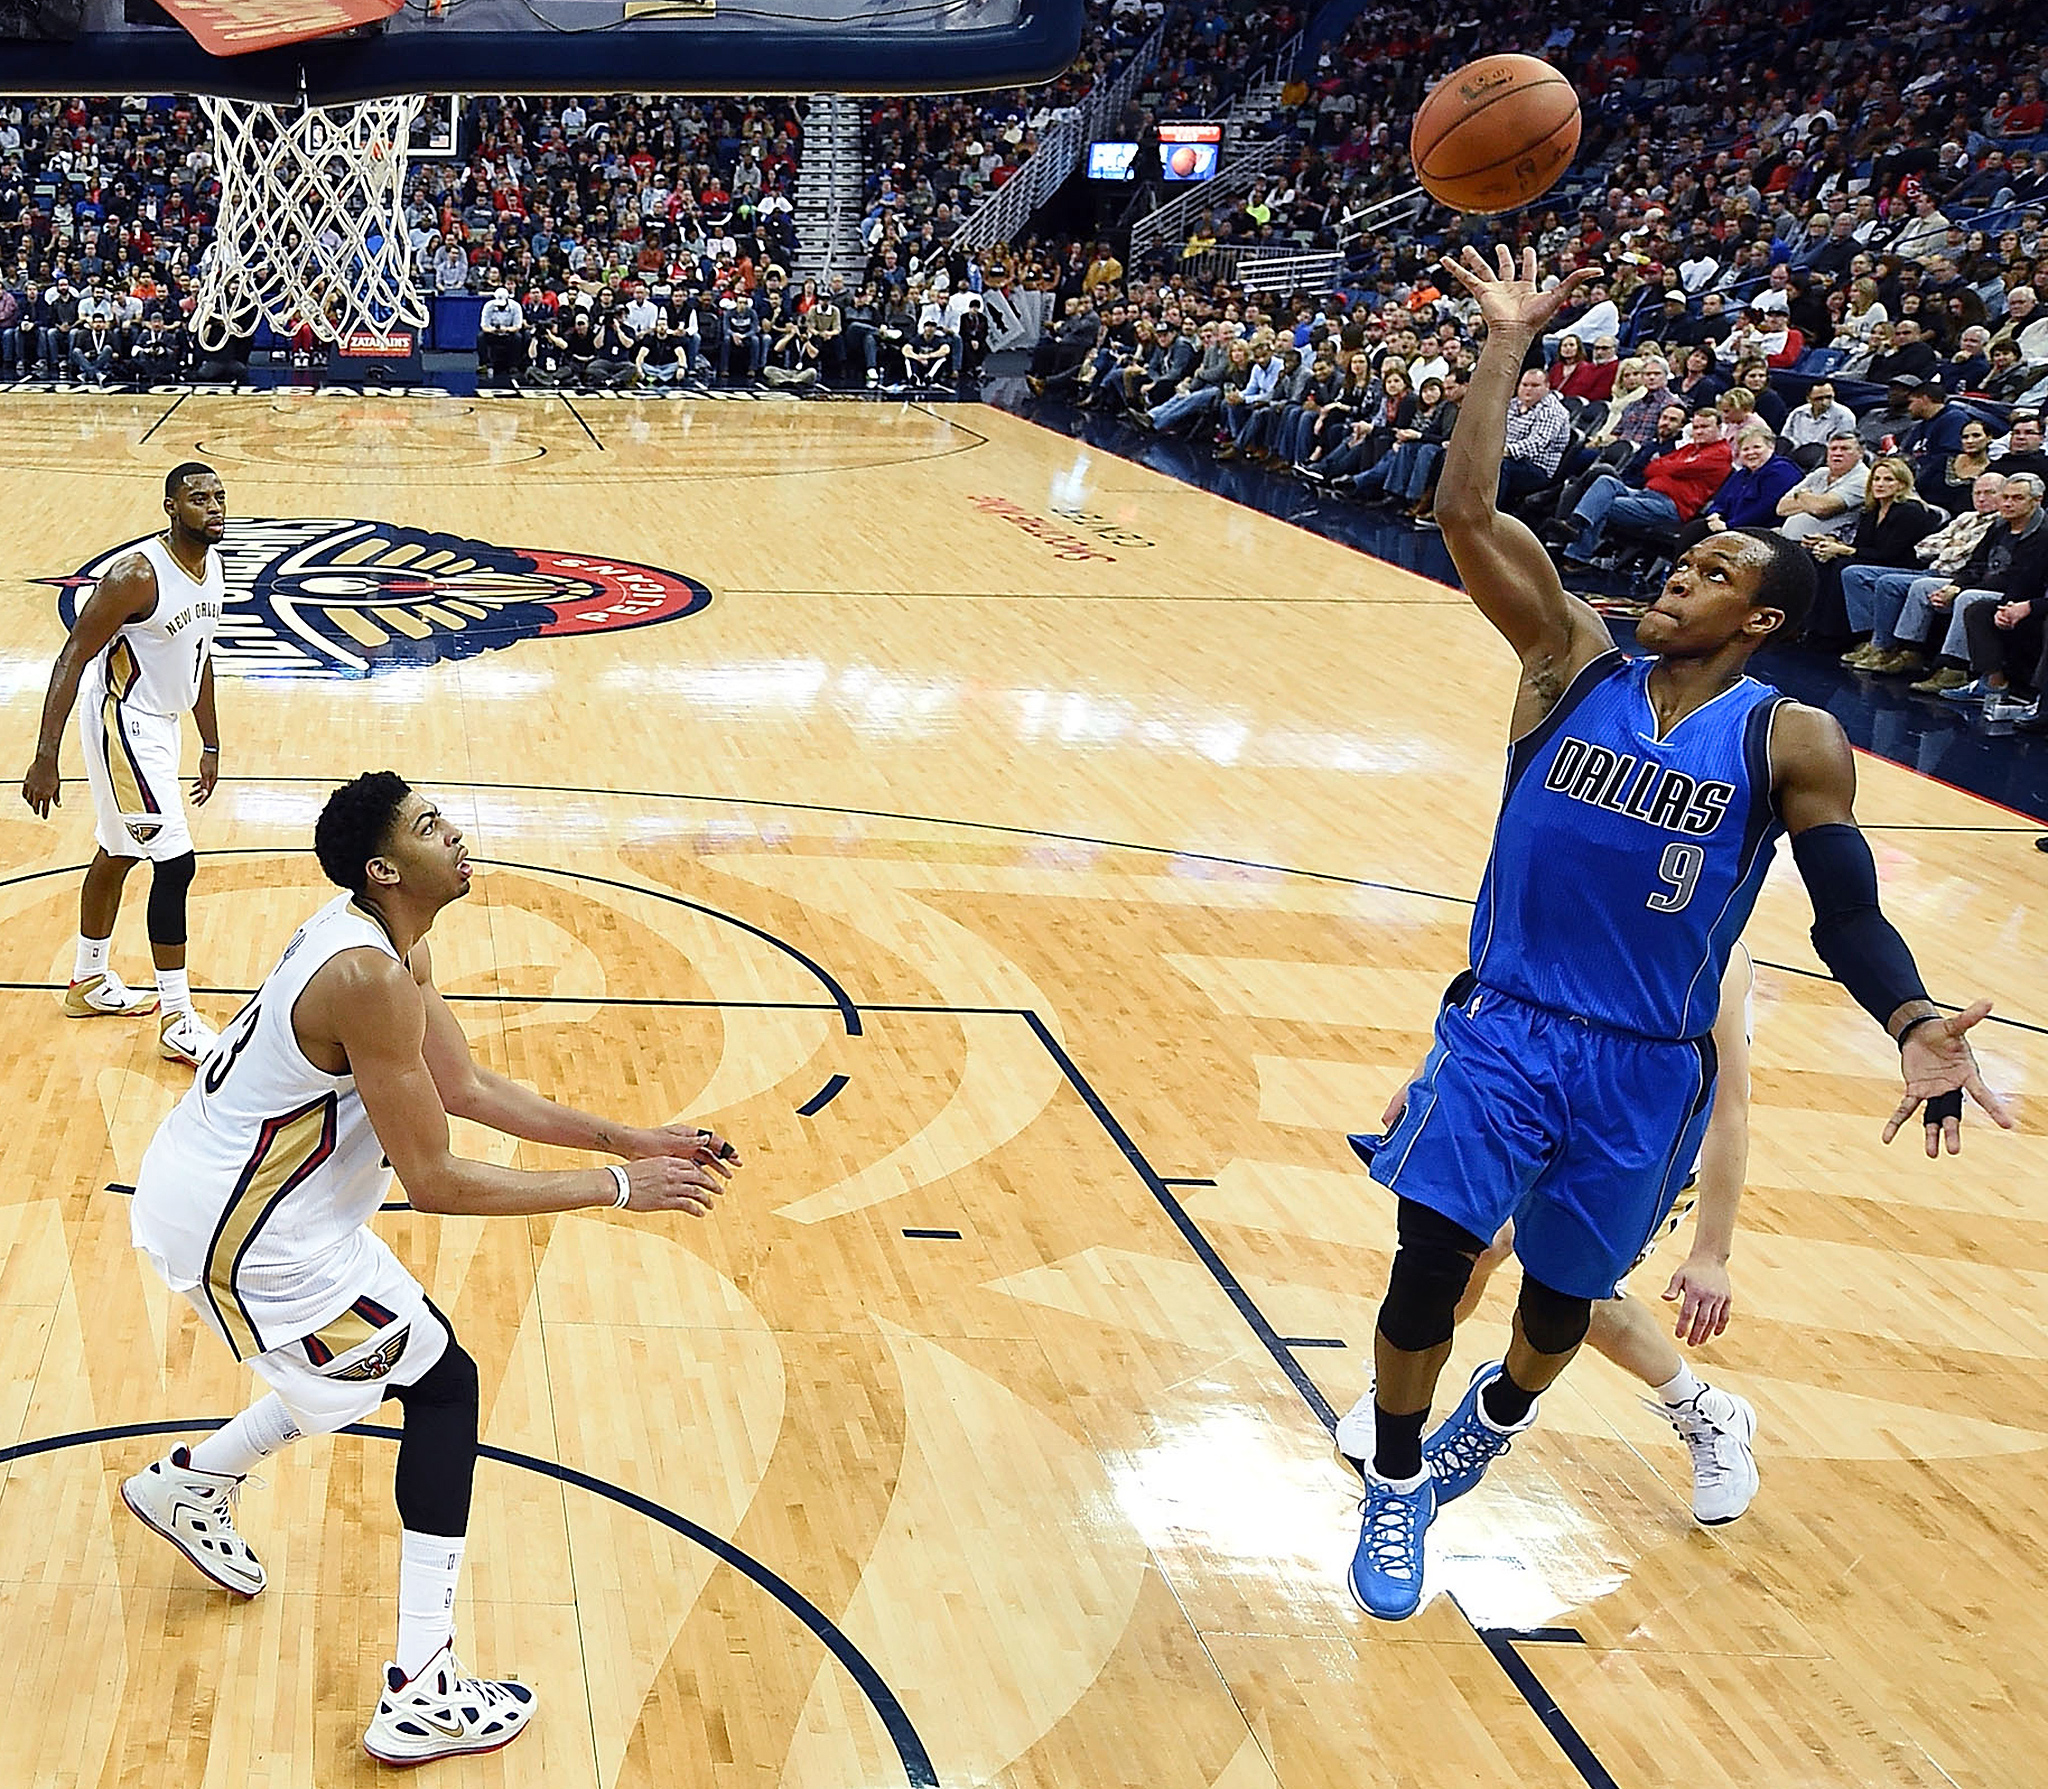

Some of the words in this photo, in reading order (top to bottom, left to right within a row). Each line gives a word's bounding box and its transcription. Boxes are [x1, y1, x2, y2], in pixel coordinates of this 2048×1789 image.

[0, 383, 129, 394] EW
[148, 384, 450, 399] ORLEANS
[474, 387, 803, 401] PELICANS
[165, 607, 192, 637] NEW
[552, 558, 668, 623] PELICANS
[1544, 736, 1736, 836] DALLAS
[1646, 842, 1704, 913] 9
